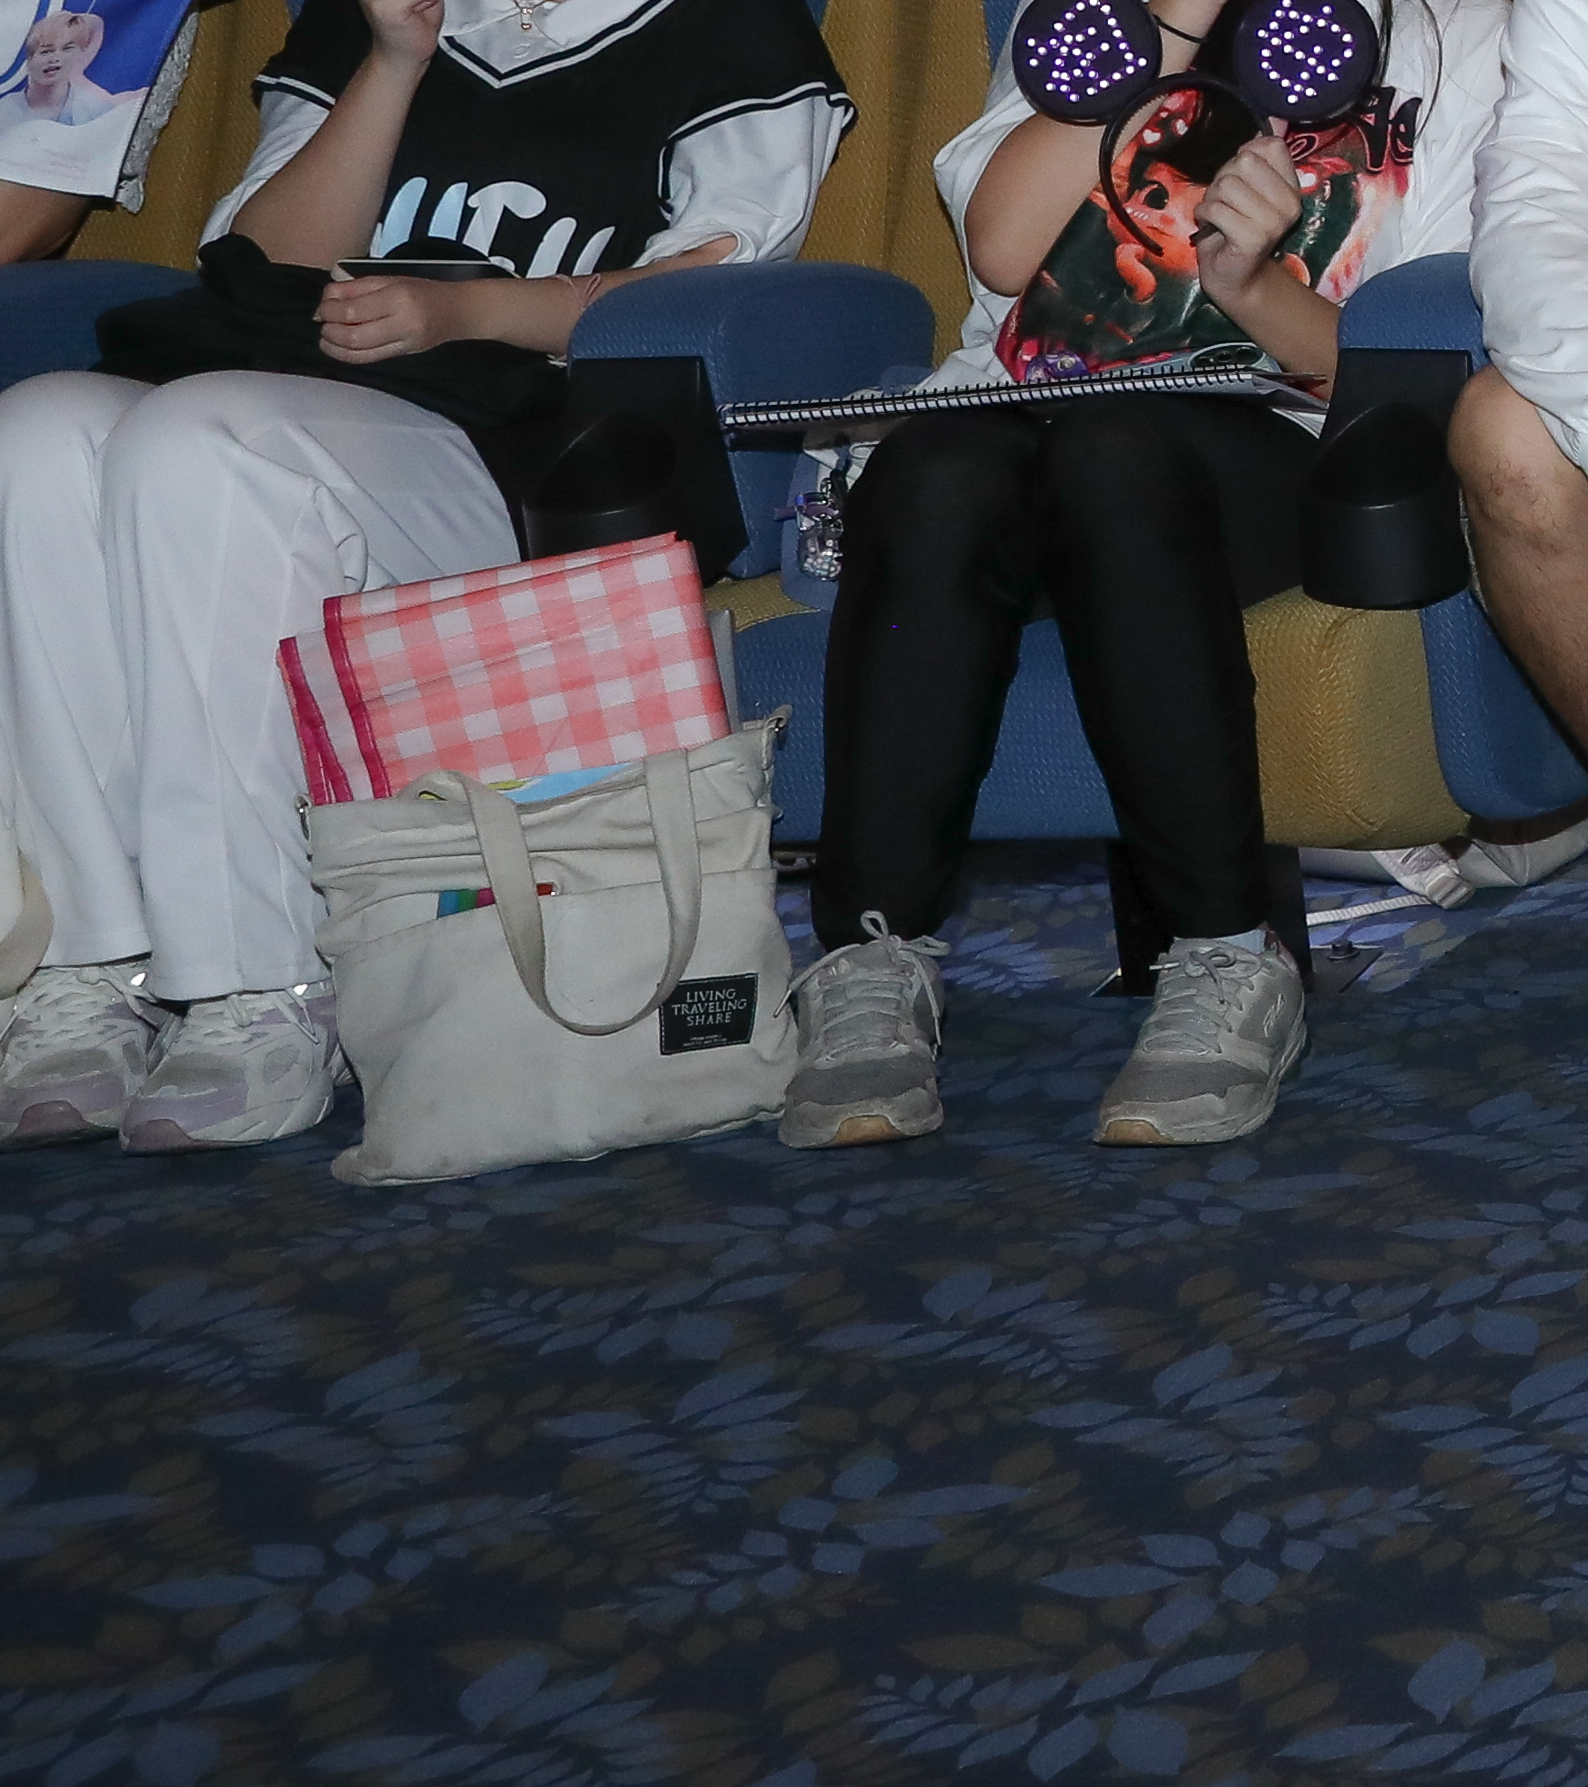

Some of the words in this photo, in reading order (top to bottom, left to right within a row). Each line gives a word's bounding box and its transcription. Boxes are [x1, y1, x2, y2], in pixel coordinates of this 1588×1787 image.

[686, 988, 737, 1004] LIVING
[671, 998, 748, 1016] TRAVELING
[686, 1012, 732, 1027] SHARE
